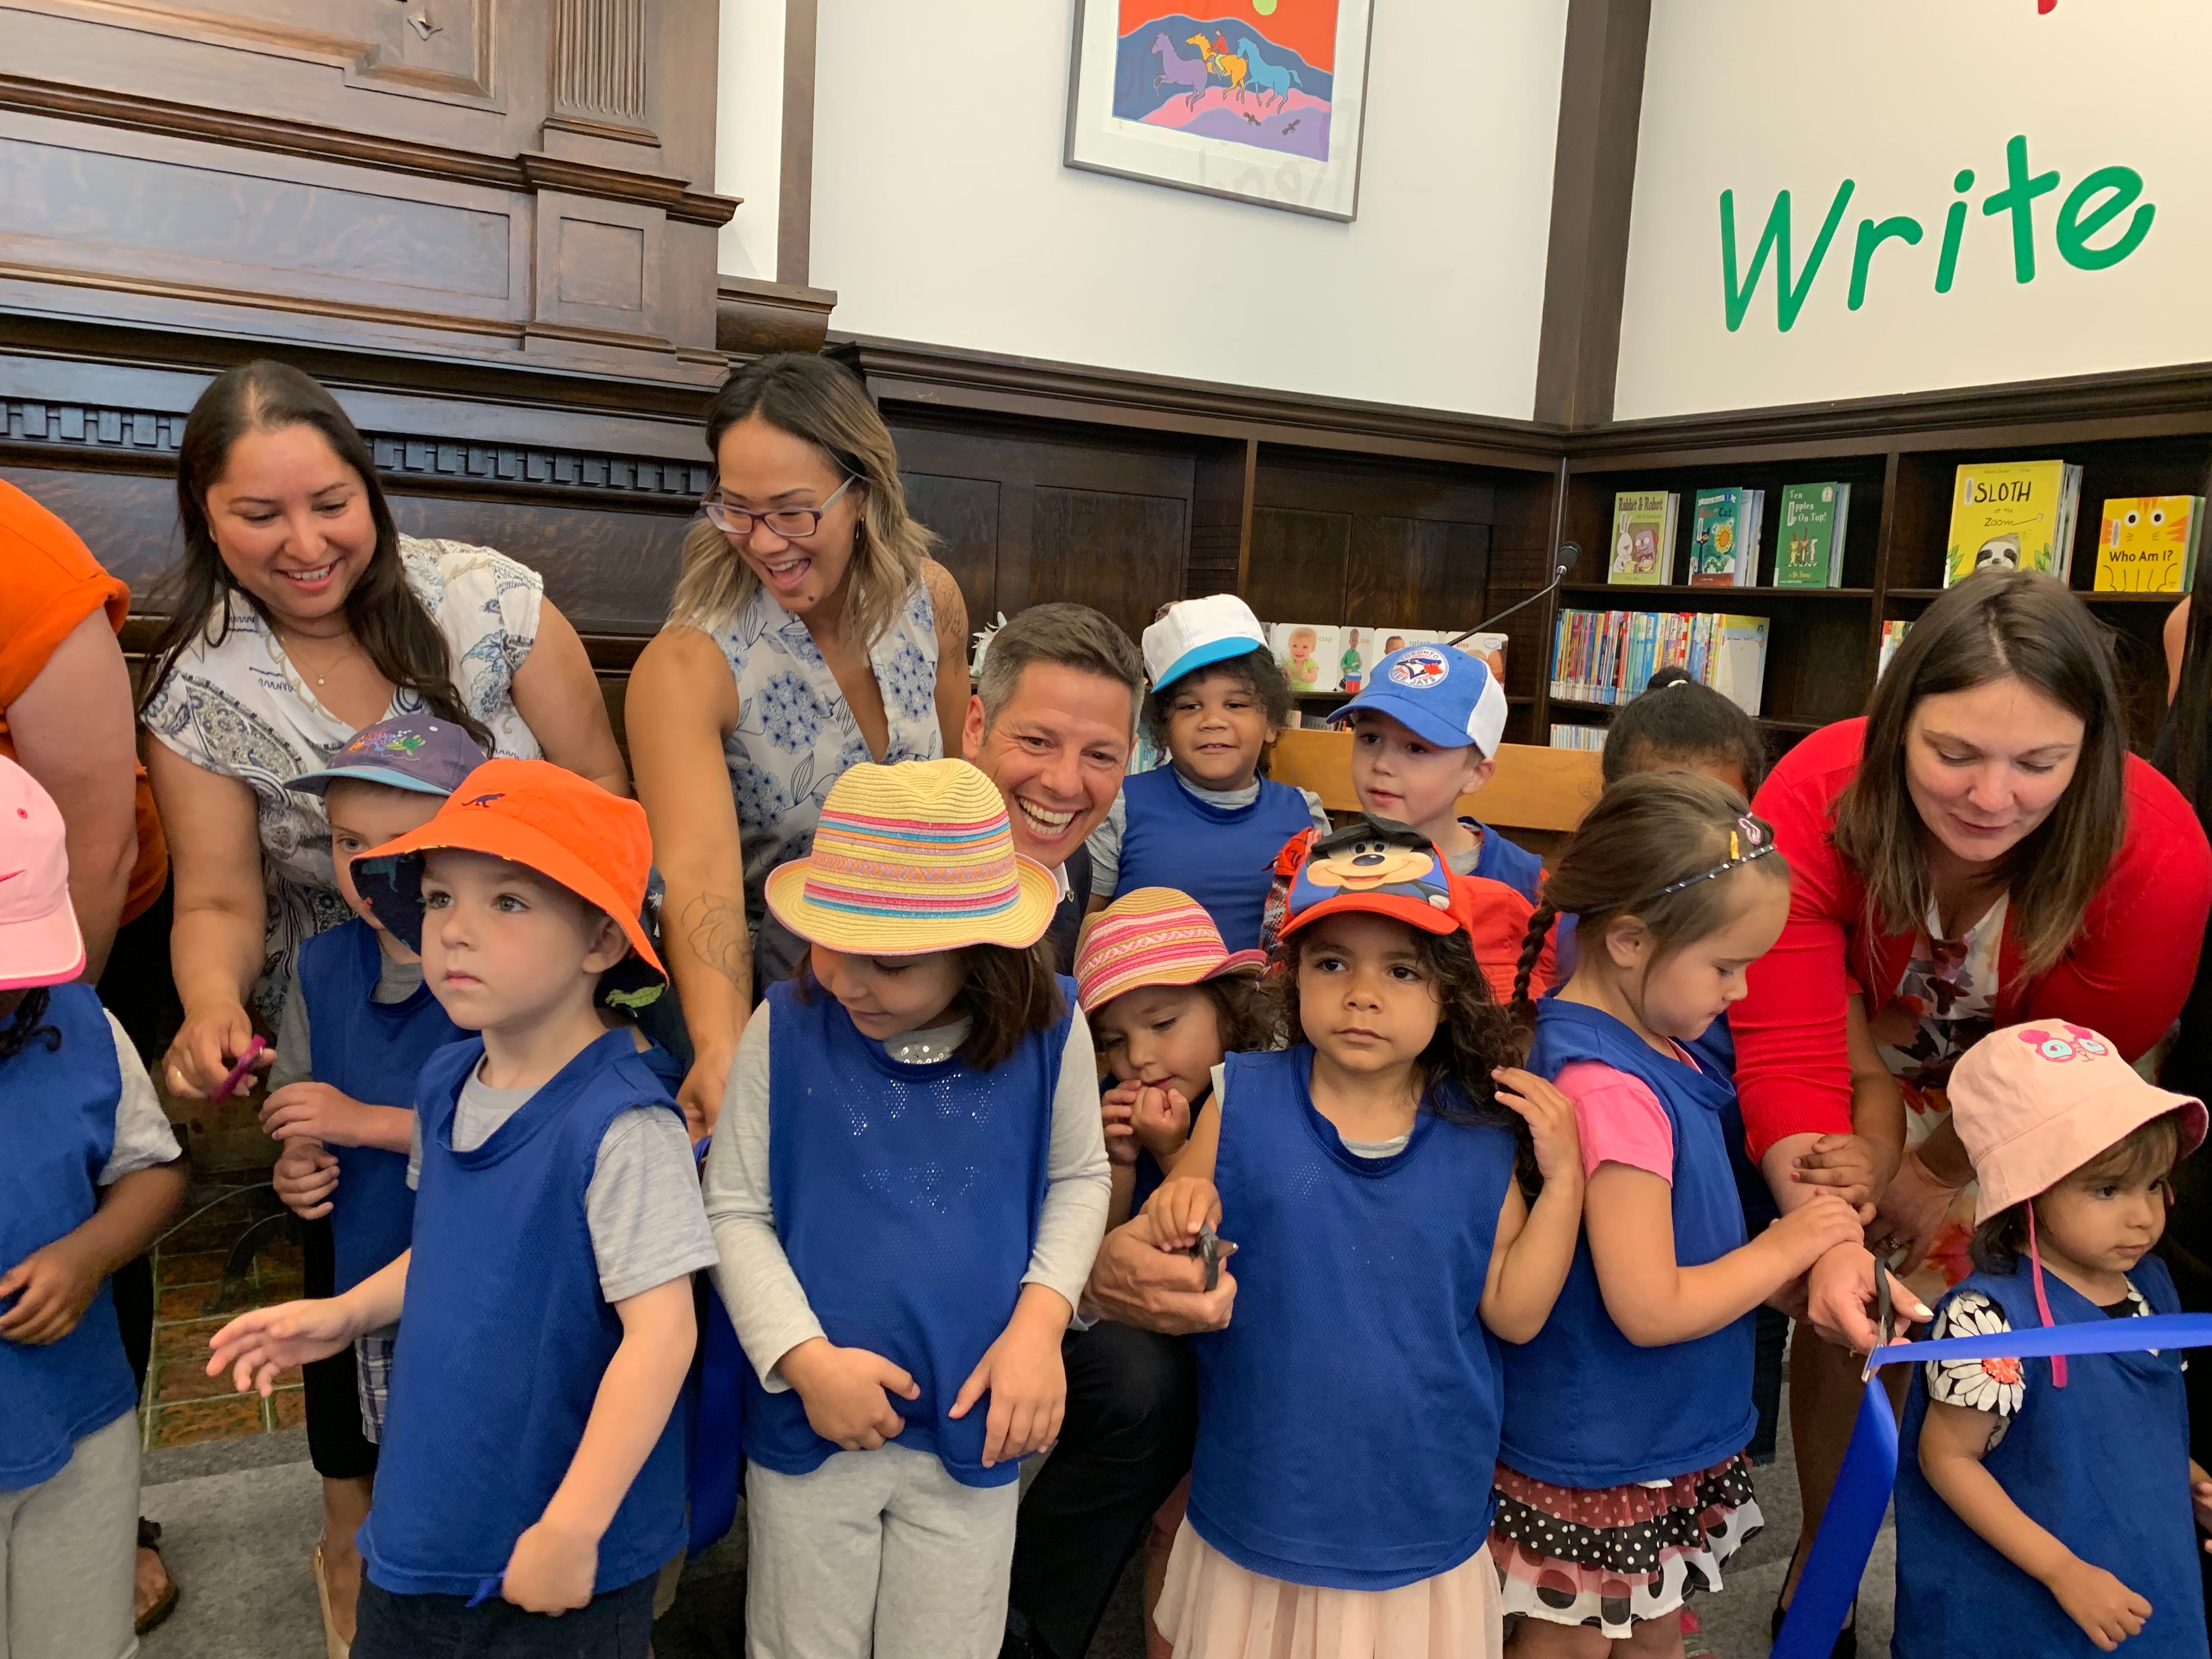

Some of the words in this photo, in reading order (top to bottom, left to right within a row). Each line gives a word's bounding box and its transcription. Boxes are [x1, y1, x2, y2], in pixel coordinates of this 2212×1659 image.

[1719, 134, 2156, 332] Write
[1790, 489, 1803, 499] Ten
[1974, 481, 2032, 503] SLOTH
[1618, 496, 1637, 511] Rabbit
[1638, 496, 1643, 511] &
[1644, 496, 1663, 511] Robot
[1795, 501, 1814, 512] pples
[1719, 507, 1732, 517] Cat
[1798, 513, 1809, 522] On
[1811, 511, 1826, 523] Top!
[1984, 517, 2016, 527] Zoom
[2109, 550, 2136, 562] Who
[2139, 551, 2158, 562] Am
[2163, 550, 2173, 561] I?
[1410, 675, 1436, 685] JAYS
